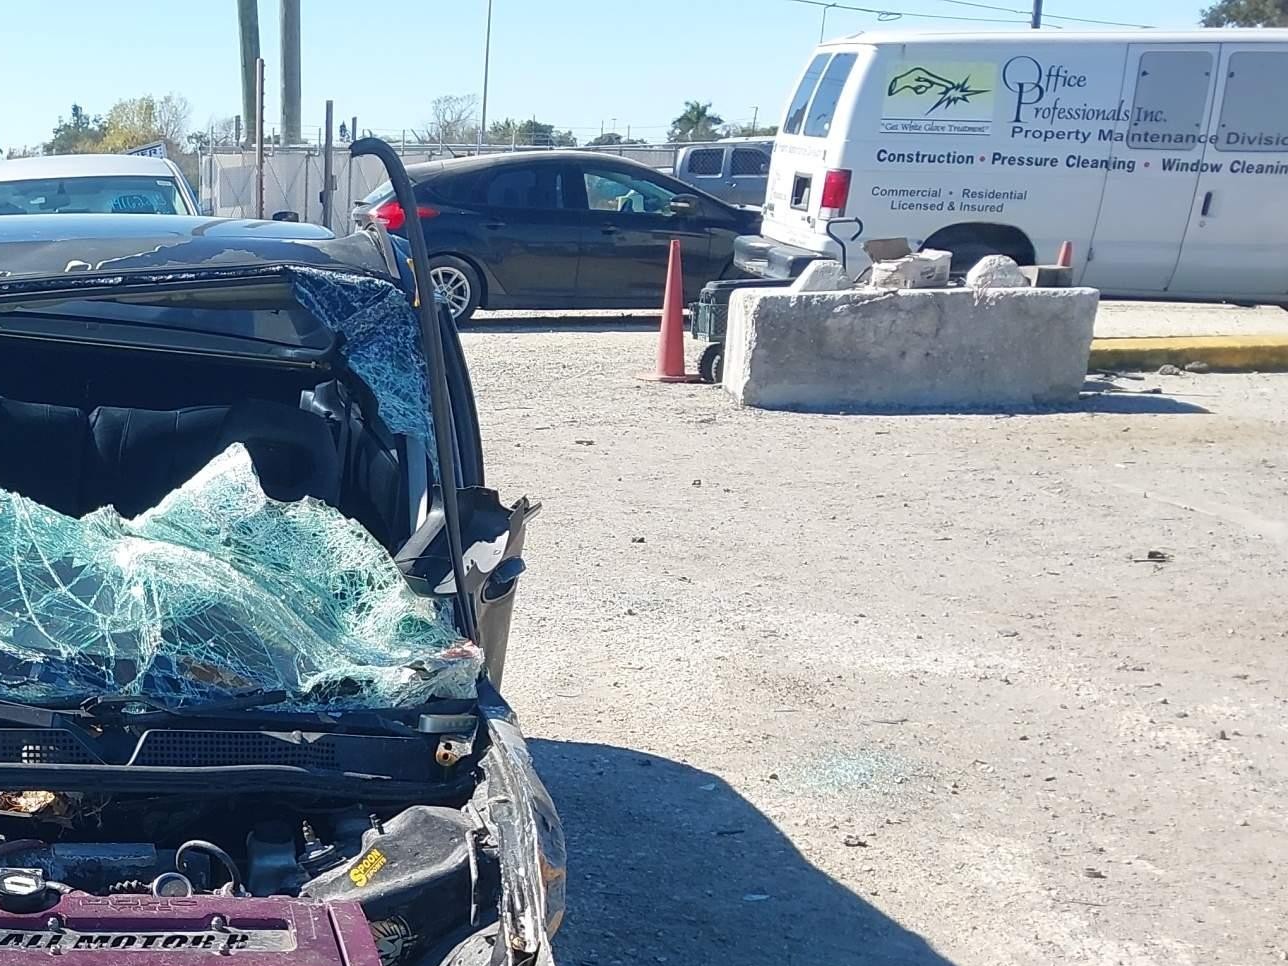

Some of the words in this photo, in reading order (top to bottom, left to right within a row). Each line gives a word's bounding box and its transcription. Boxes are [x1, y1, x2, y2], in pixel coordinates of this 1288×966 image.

[1002, 56, 1087, 92] Office
[1008, 82, 1130, 125] Professionals
[1136, 107, 1167, 122] Inc.
[1011, 126, 1091, 144] Property
[1098, 129, 1219, 145] Maintenance
[876, 149, 974, 164] Construction
[991, 152, 1059, 167] Pressure
[1065, 154, 1136, 172] Cleaning
[1162, 158, 1223, 173] Window
[871, 186, 942, 198] Commercial
[962, 188, 1027, 201] Residential
[890, 200, 944, 211] Licensed
[947, 202, 956, 212] &
[959, 201, 1004, 213] Insured
[349, 848, 381, 887] SPOON
[73, 934, 216, 949] MOTOR
